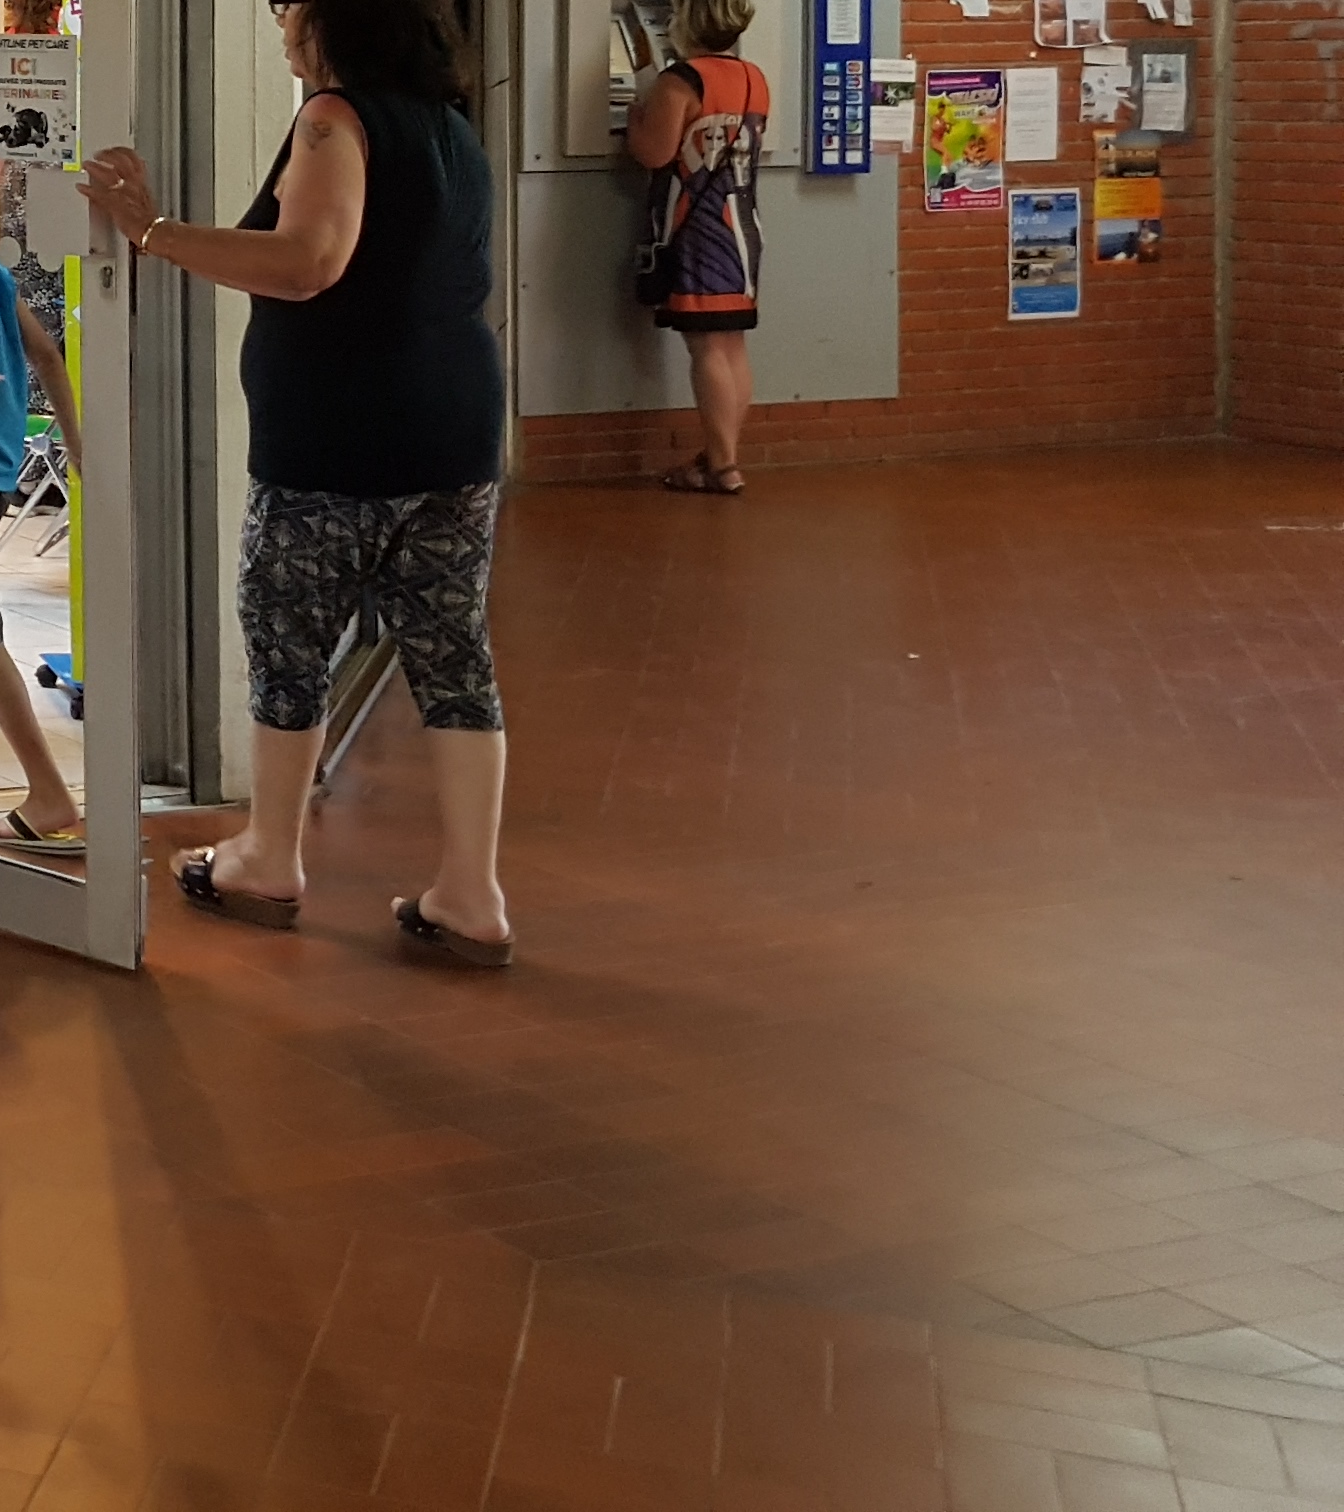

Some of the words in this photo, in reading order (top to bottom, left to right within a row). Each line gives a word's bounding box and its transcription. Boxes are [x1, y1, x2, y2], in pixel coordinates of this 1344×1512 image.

[27, 39, 45, 49] PET
[45, 40, 69, 49] CARE
[10, 57, 38, 75] ICI
